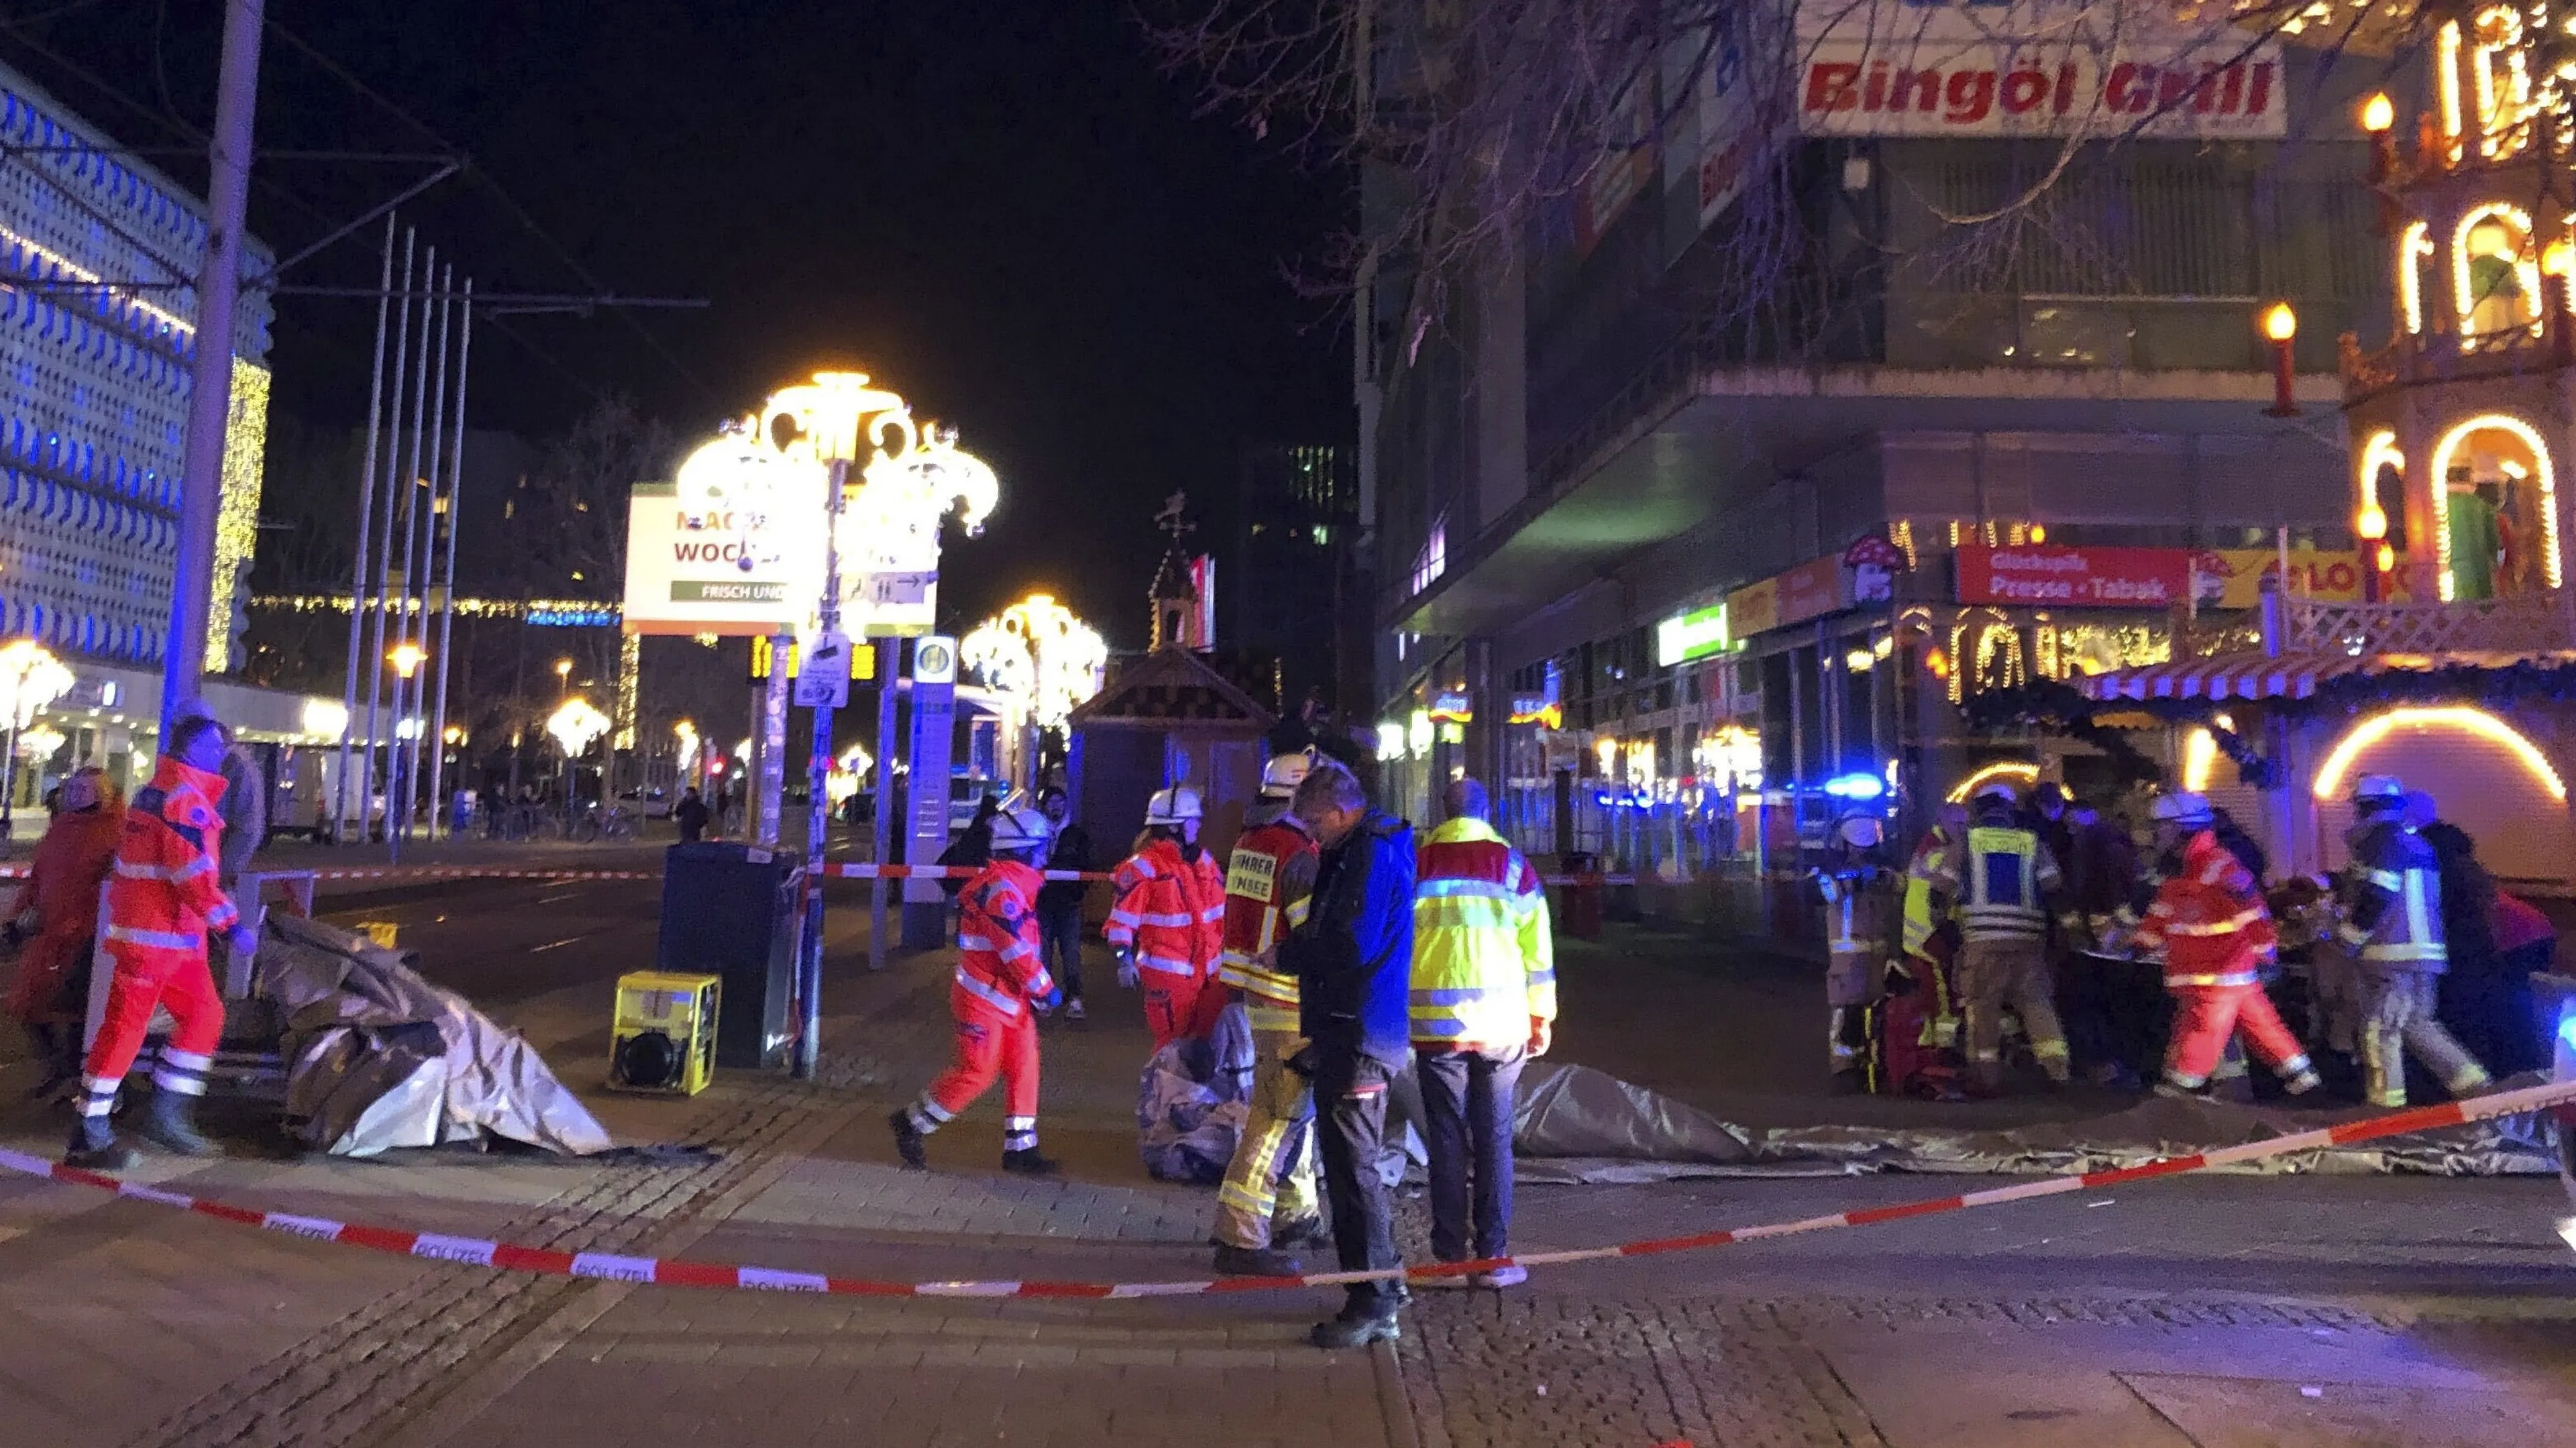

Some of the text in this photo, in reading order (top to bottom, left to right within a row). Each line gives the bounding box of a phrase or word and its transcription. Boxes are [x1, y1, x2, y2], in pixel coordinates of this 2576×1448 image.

[1804, 58, 2078, 125] Bingöl
[2104, 61, 2275, 115] Grill
[674, 543, 747, 563] WOC
[702, 584, 751, 599] FRISCH
[1990, 576, 2167, 600] Presse Tabak
[415, 1242, 486, 1267] POLIZEI
